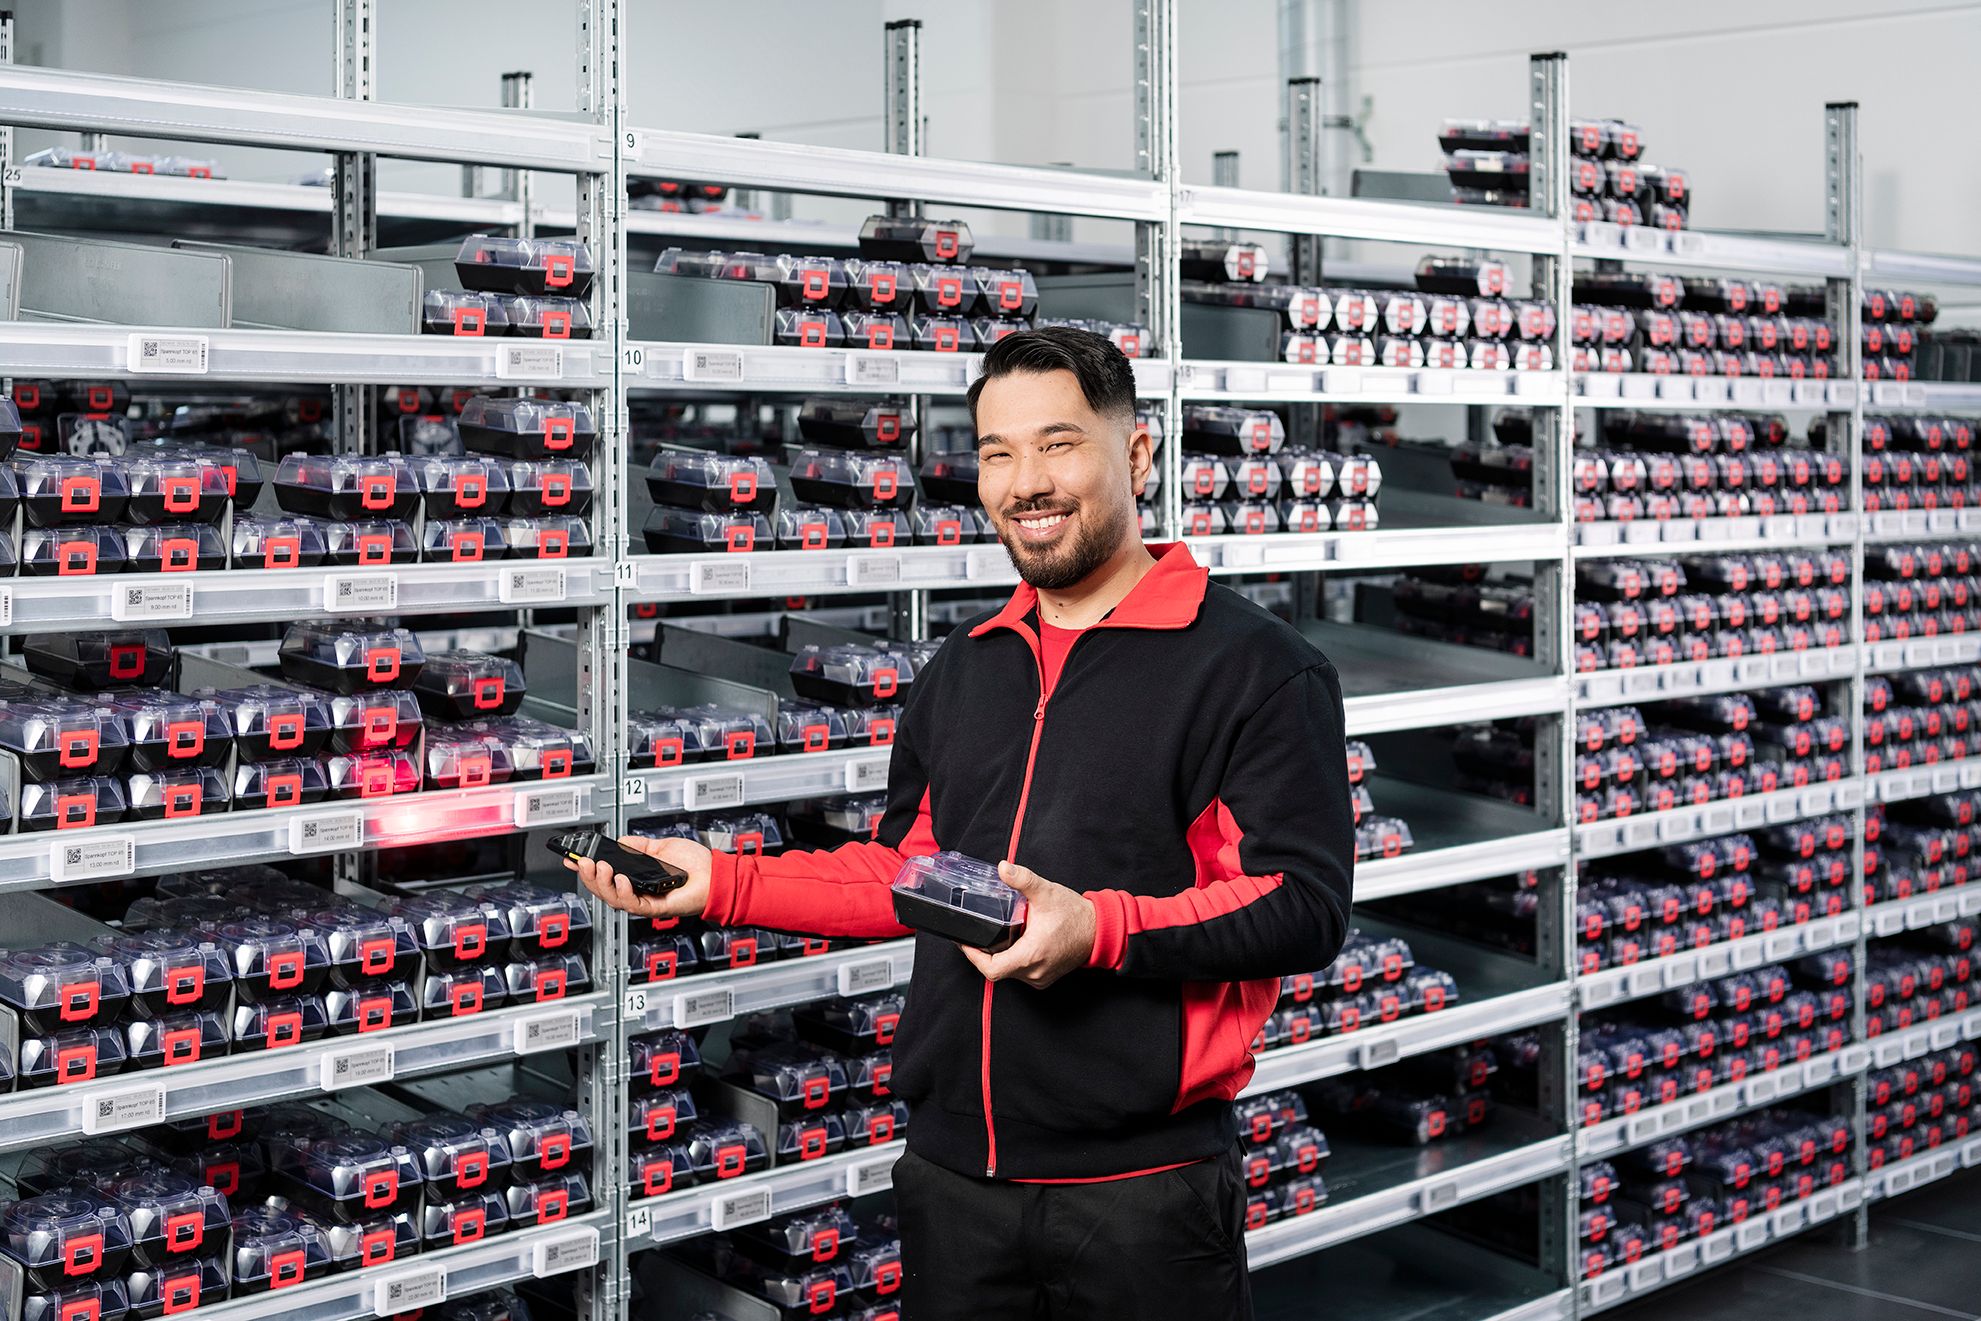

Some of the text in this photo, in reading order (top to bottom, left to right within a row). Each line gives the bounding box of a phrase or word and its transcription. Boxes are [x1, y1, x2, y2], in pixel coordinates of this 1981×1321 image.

[626, 133, 635, 148] 9
[5, 169, 20, 181] 25
[624, 349, 642, 365] 10
[617, 564, 631, 579] 11
[625, 779, 642, 795] 12
[628, 994, 645, 1011] 13
[630, 1210, 647, 1229] 14
